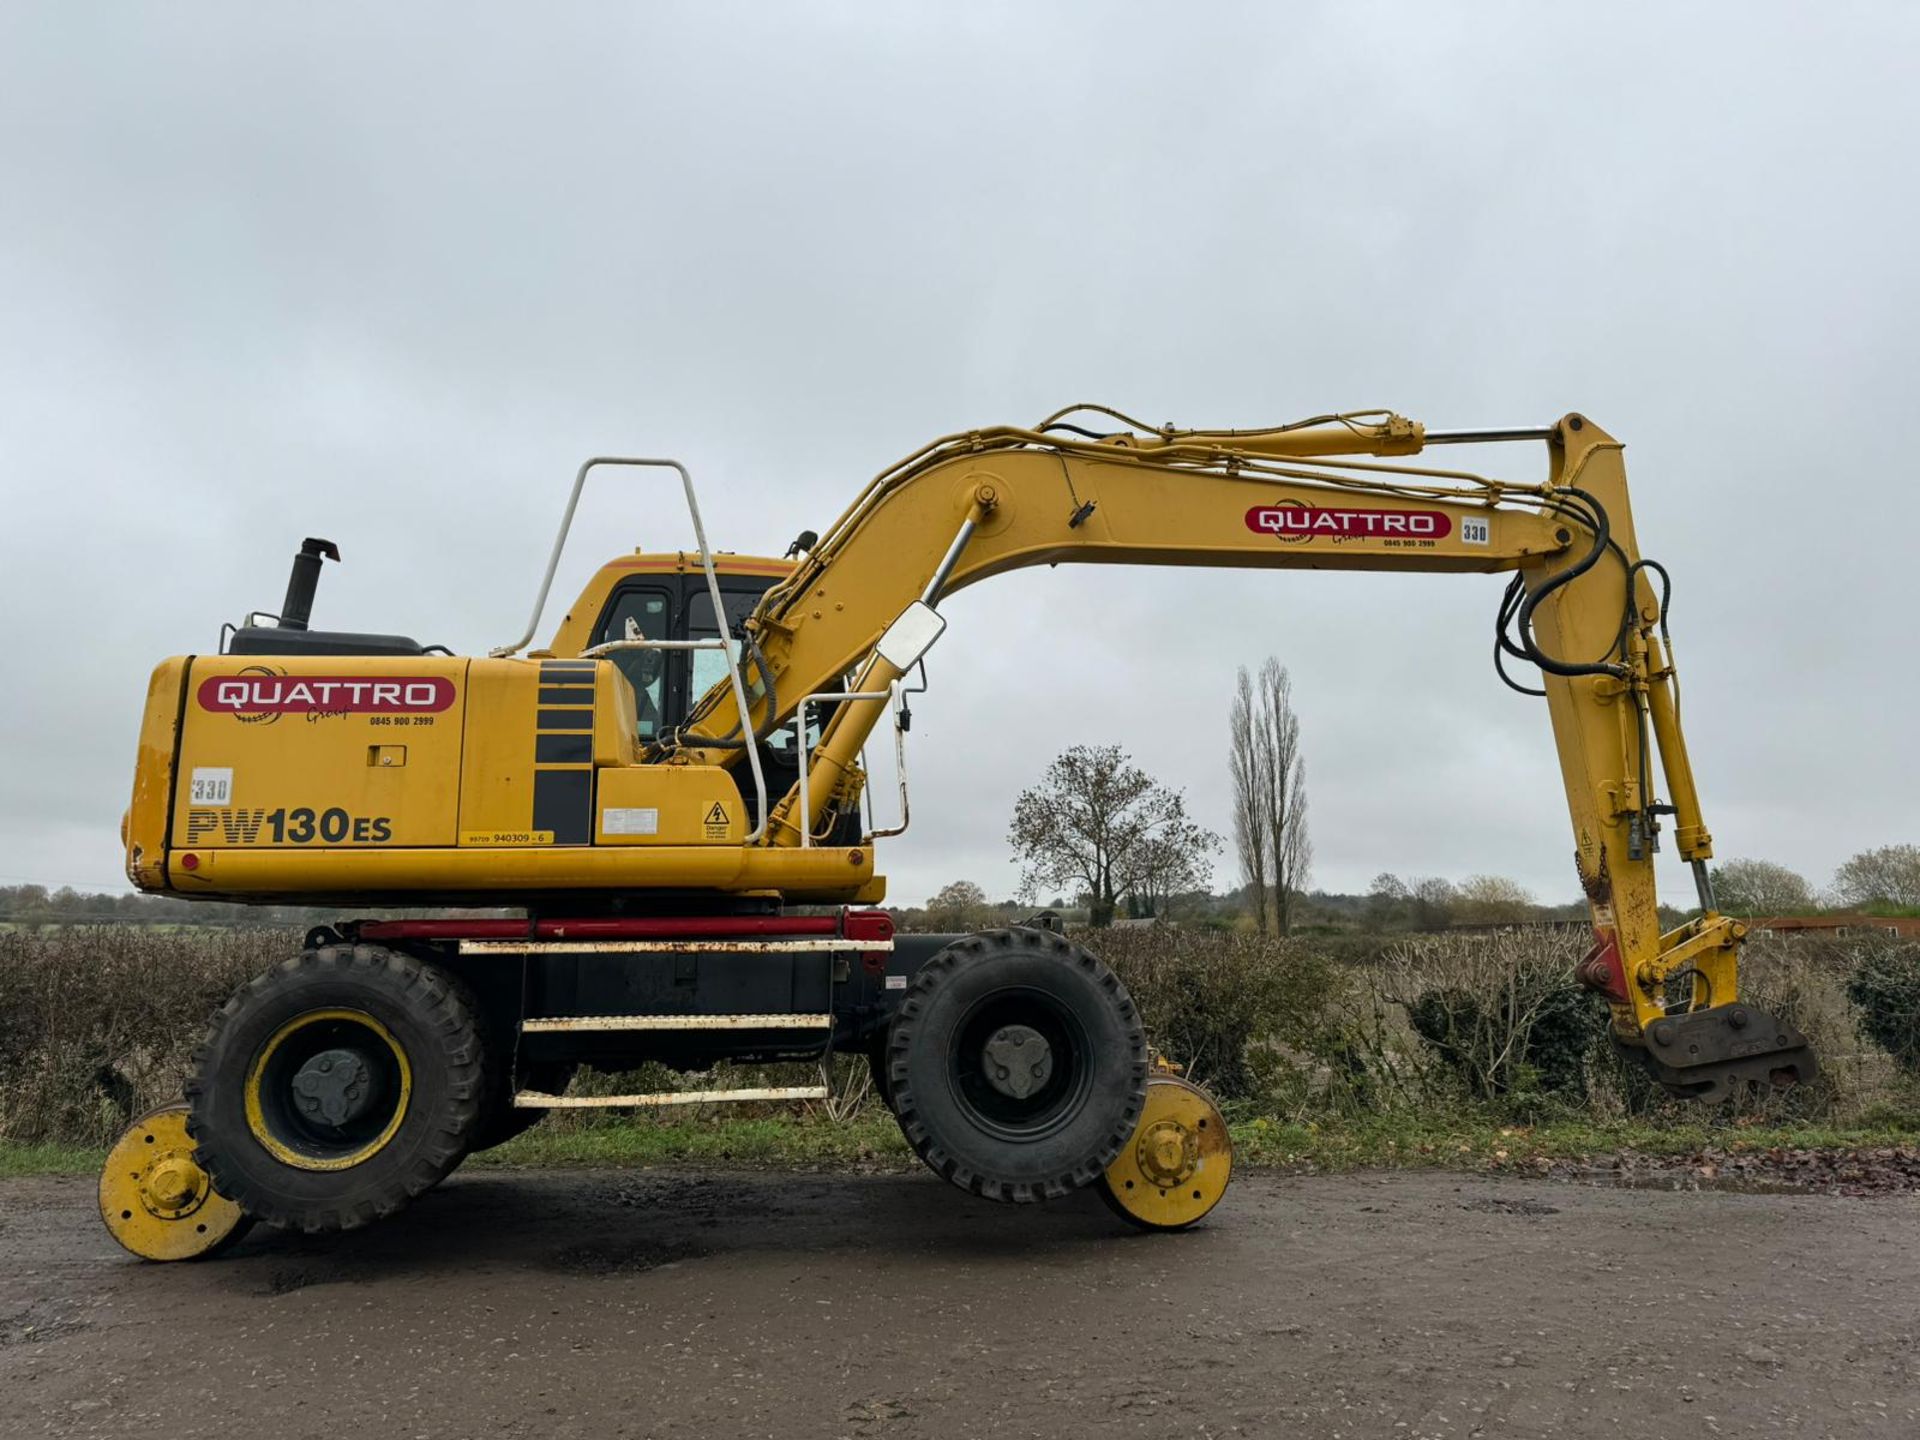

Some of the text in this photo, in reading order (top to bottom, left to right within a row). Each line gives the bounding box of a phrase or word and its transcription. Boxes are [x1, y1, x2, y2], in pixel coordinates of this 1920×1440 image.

[1258, 510, 1435, 533] QUATTRO
[1464, 524, 1486, 542] 330
[217, 682, 436, 709] QUATTRO
[306, 704, 352, 725] Group
[370, 716, 434, 726] 0845 900 2999
[494, 833, 530, 843] 940309
[538, 833, 545, 843] 6
